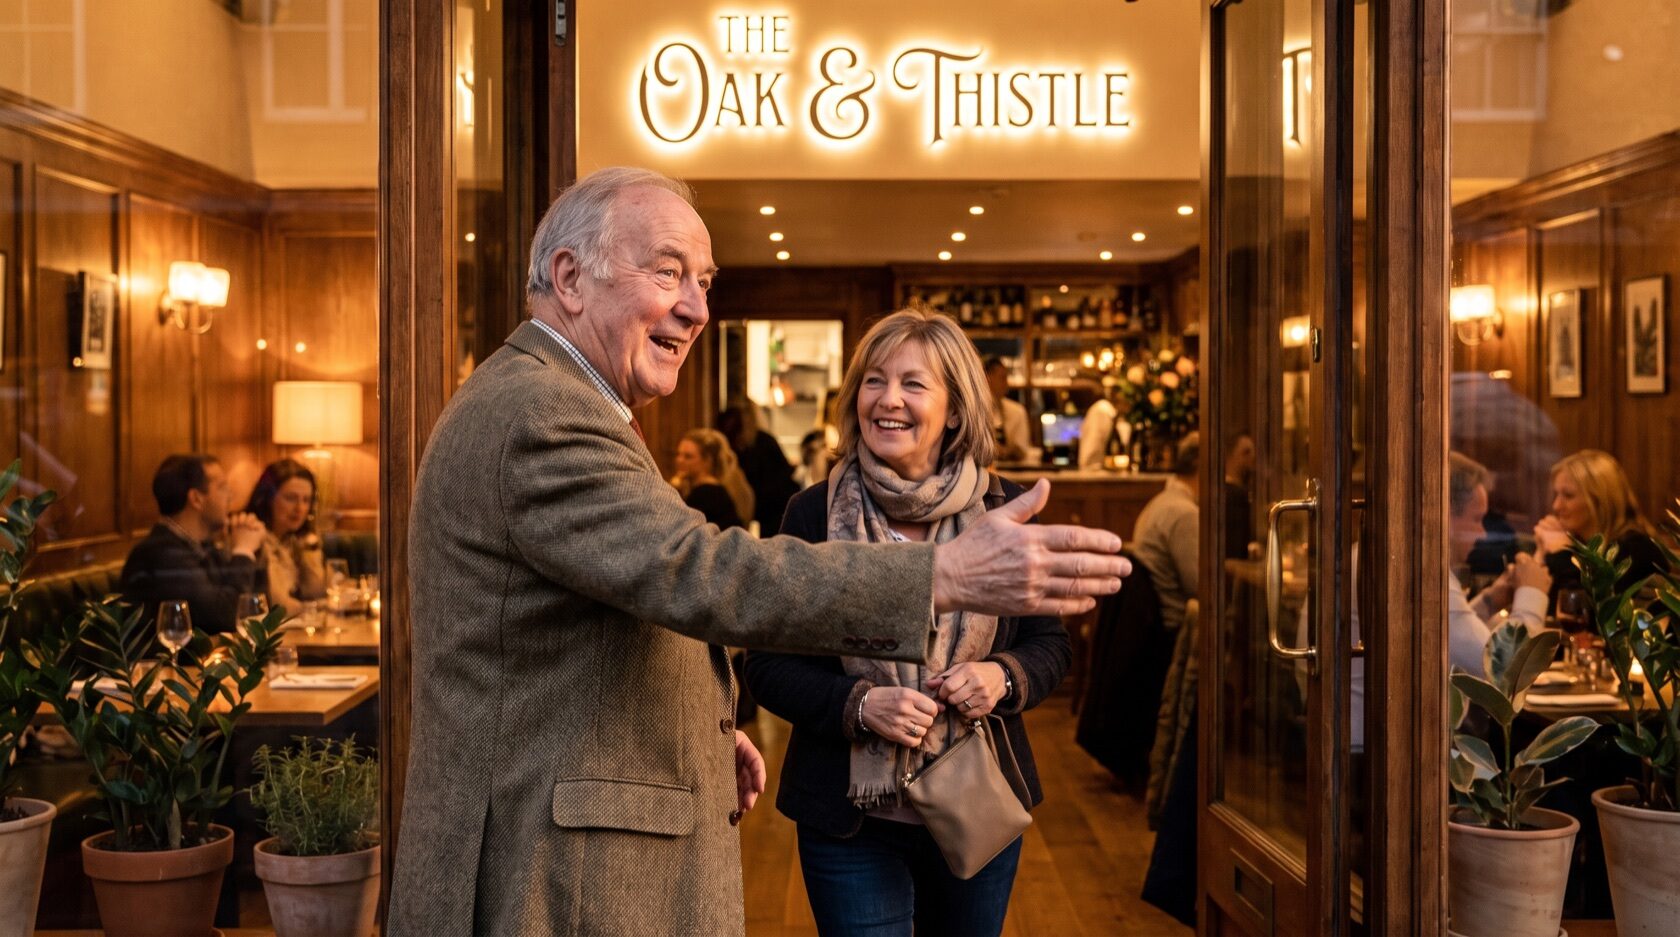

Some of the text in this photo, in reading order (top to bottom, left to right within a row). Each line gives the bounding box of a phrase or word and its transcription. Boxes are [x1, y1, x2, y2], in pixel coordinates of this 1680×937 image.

[719, 15, 789, 53] THE
[639, 42, 1130, 147] OAK & THISTLE
